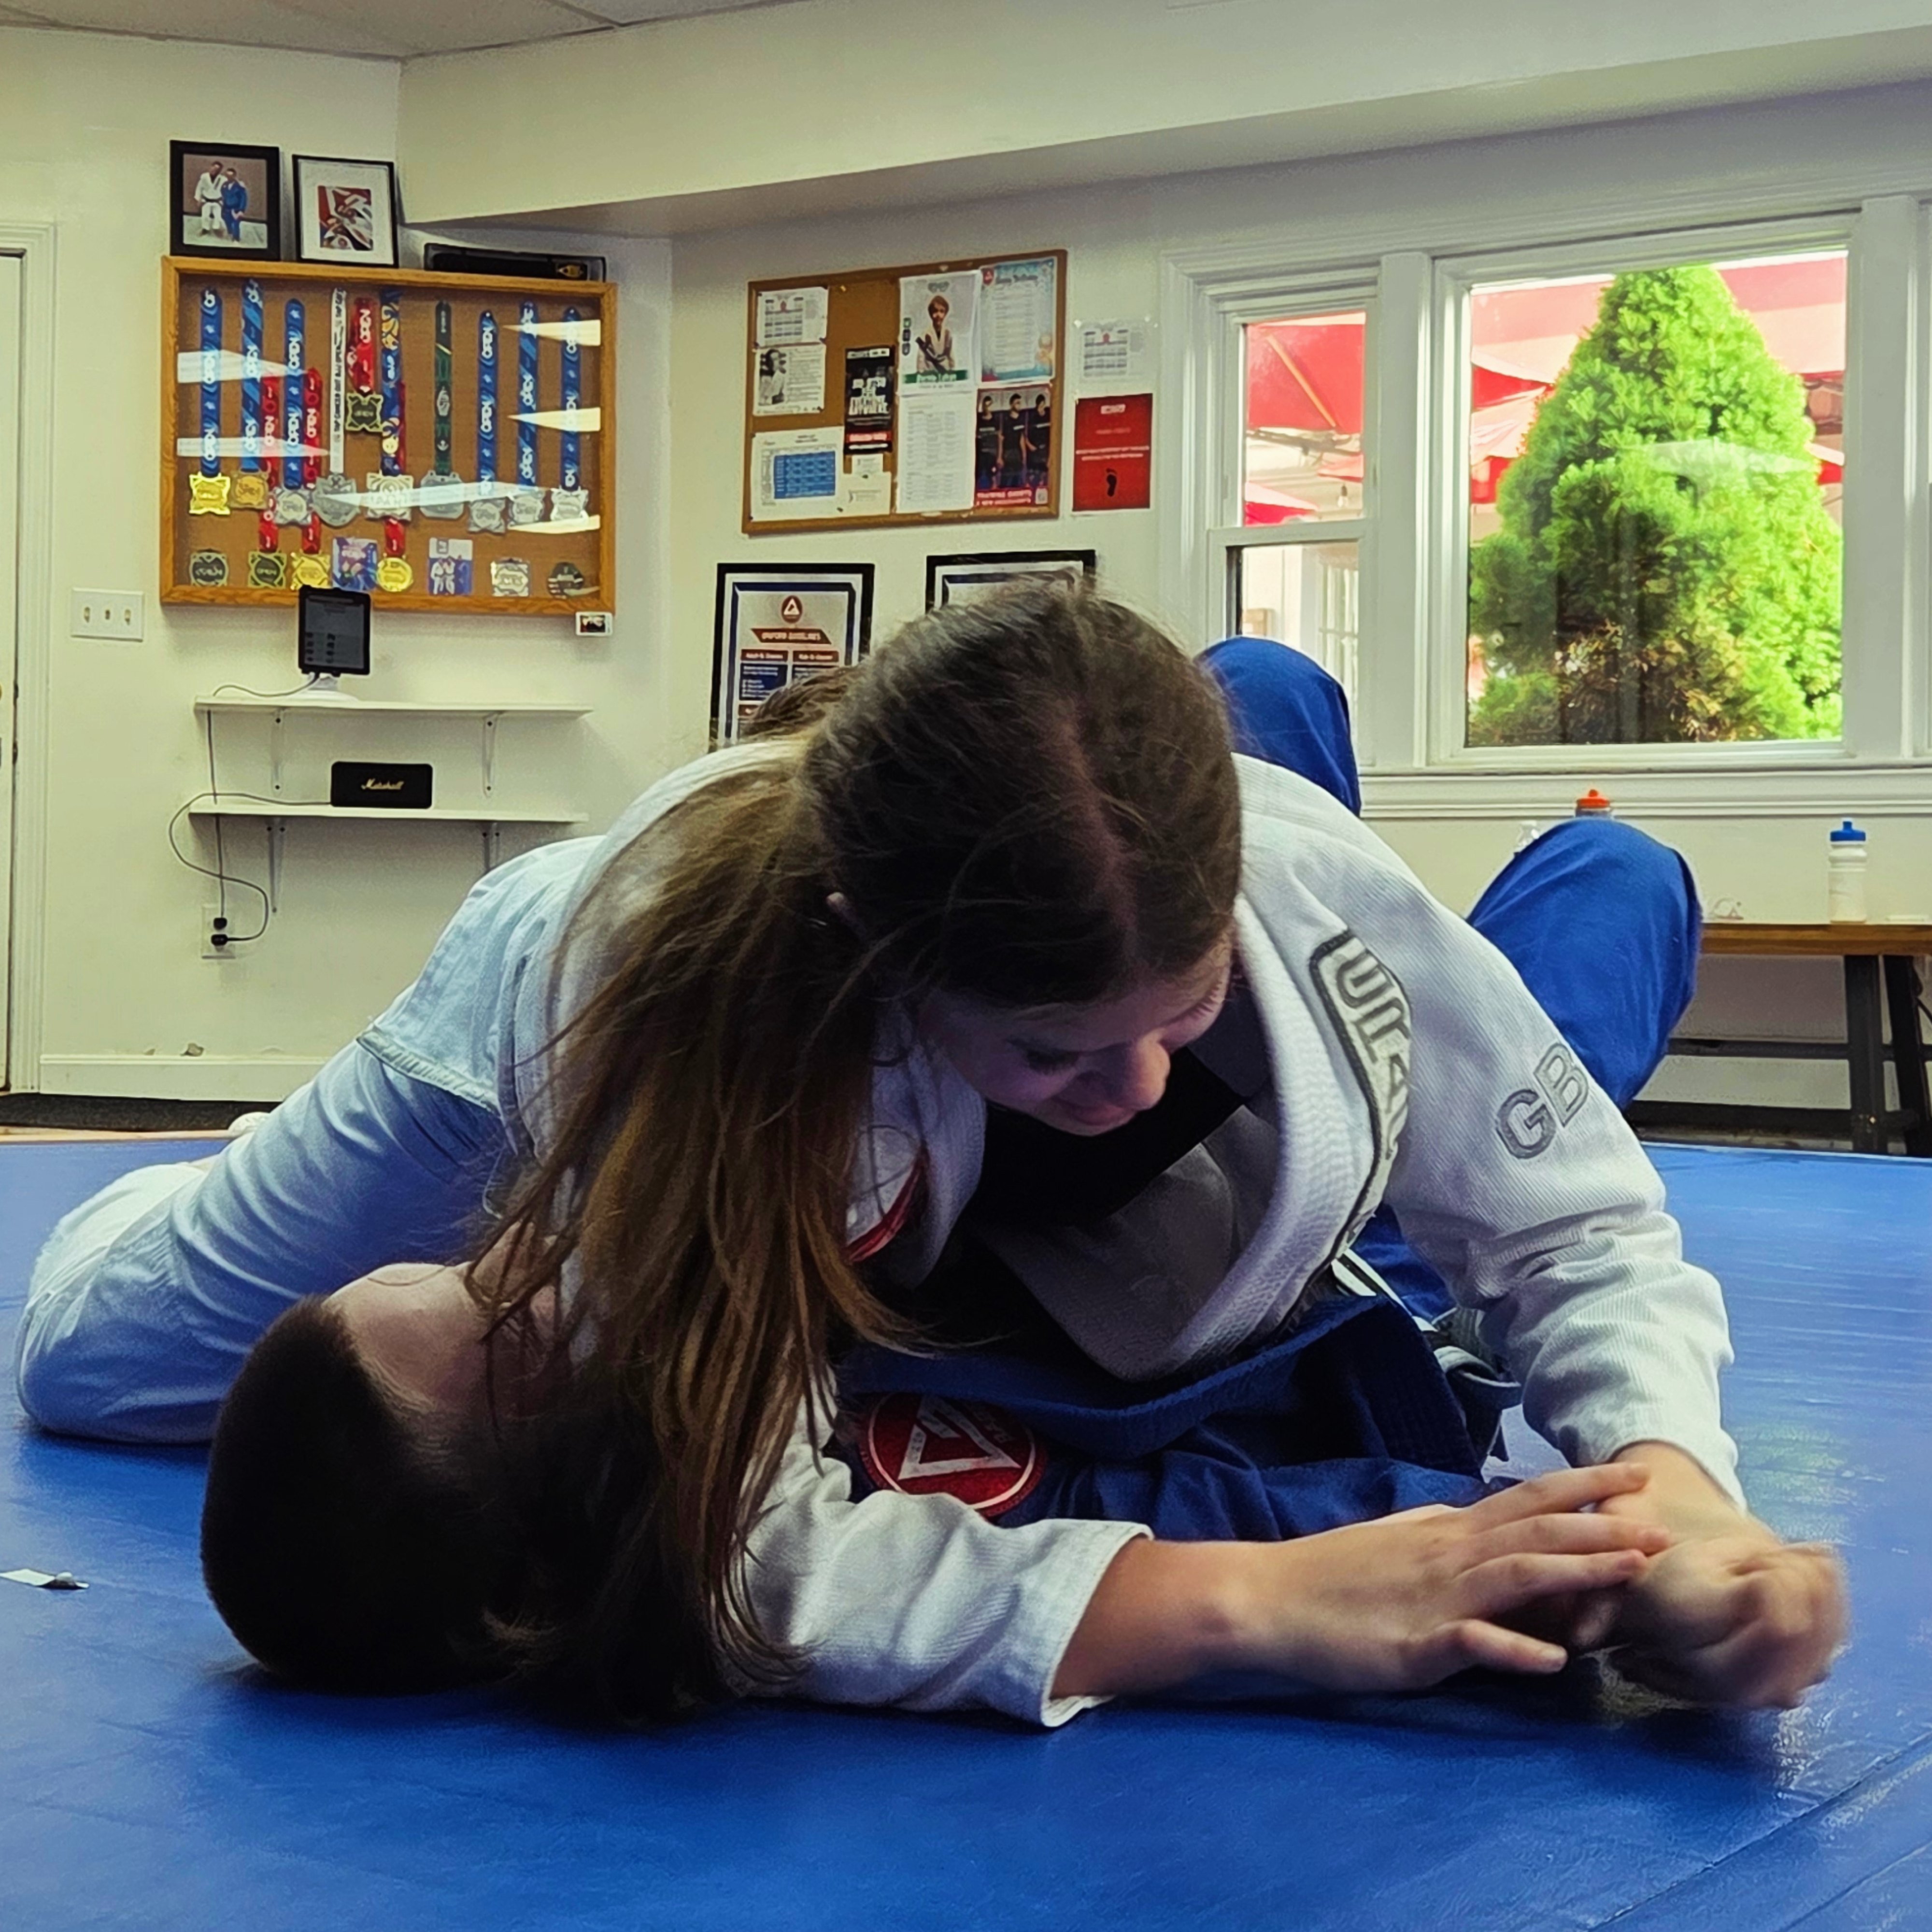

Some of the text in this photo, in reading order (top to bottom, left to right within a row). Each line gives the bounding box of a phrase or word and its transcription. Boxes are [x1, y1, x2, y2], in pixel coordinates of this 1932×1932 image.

[287, 338, 300, 369] OPEN
[481, 326, 493, 359] OPEN
[520, 373, 534, 406] OPEN
[264, 416, 274, 446] OPEN
[287, 412, 299, 445] OPEN
[305, 408, 316, 438] OPEN
[480, 400, 493, 433] OPEN
[204, 429, 216, 461] OPEN
[520, 447, 533, 479] OPEN
[1496, 1042, 1589, 1159] GB
